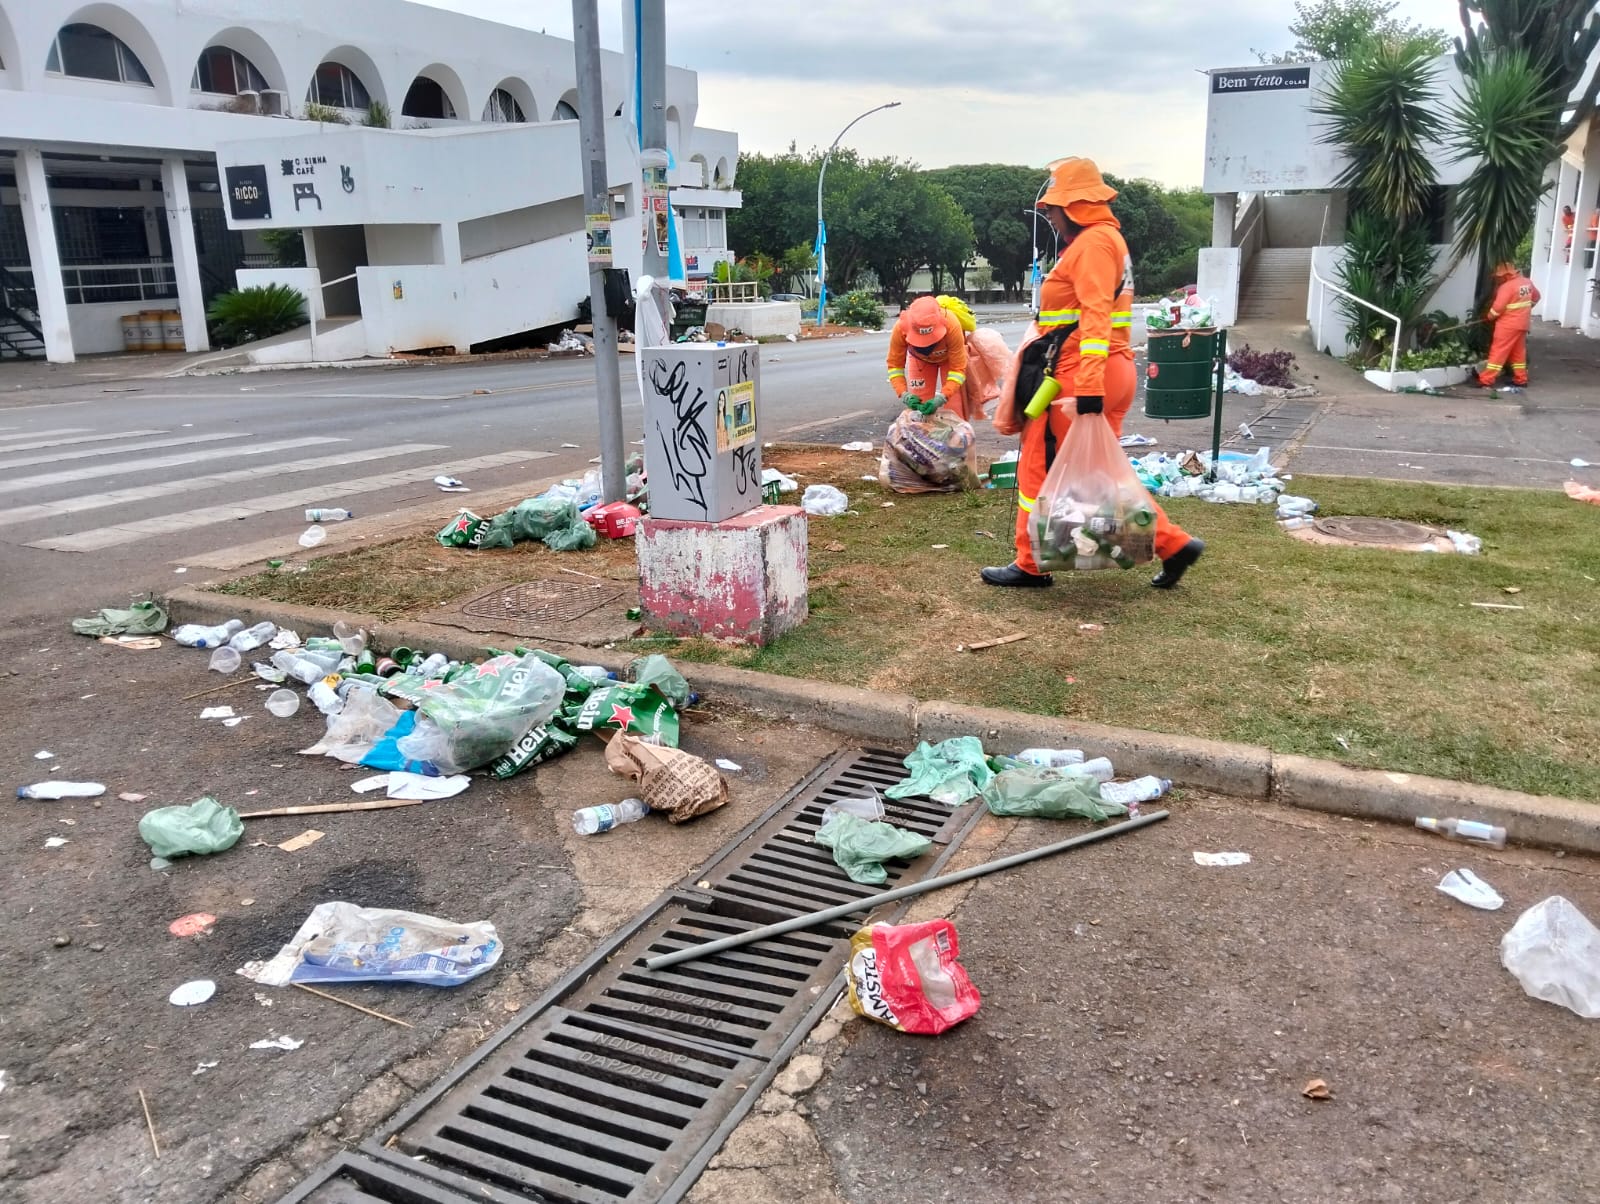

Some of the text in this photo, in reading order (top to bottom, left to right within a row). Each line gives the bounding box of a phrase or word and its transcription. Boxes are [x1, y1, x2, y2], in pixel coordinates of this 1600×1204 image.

[1218, 76, 1247, 89] Bem
[1249, 74, 1283, 87] feito
[296, 165, 315, 175] CAFÉ
[234, 186, 259, 200] RICCO
[631, 1003, 721, 1029] NOVACAP
[593, 1032, 689, 1064] NOVACAP
